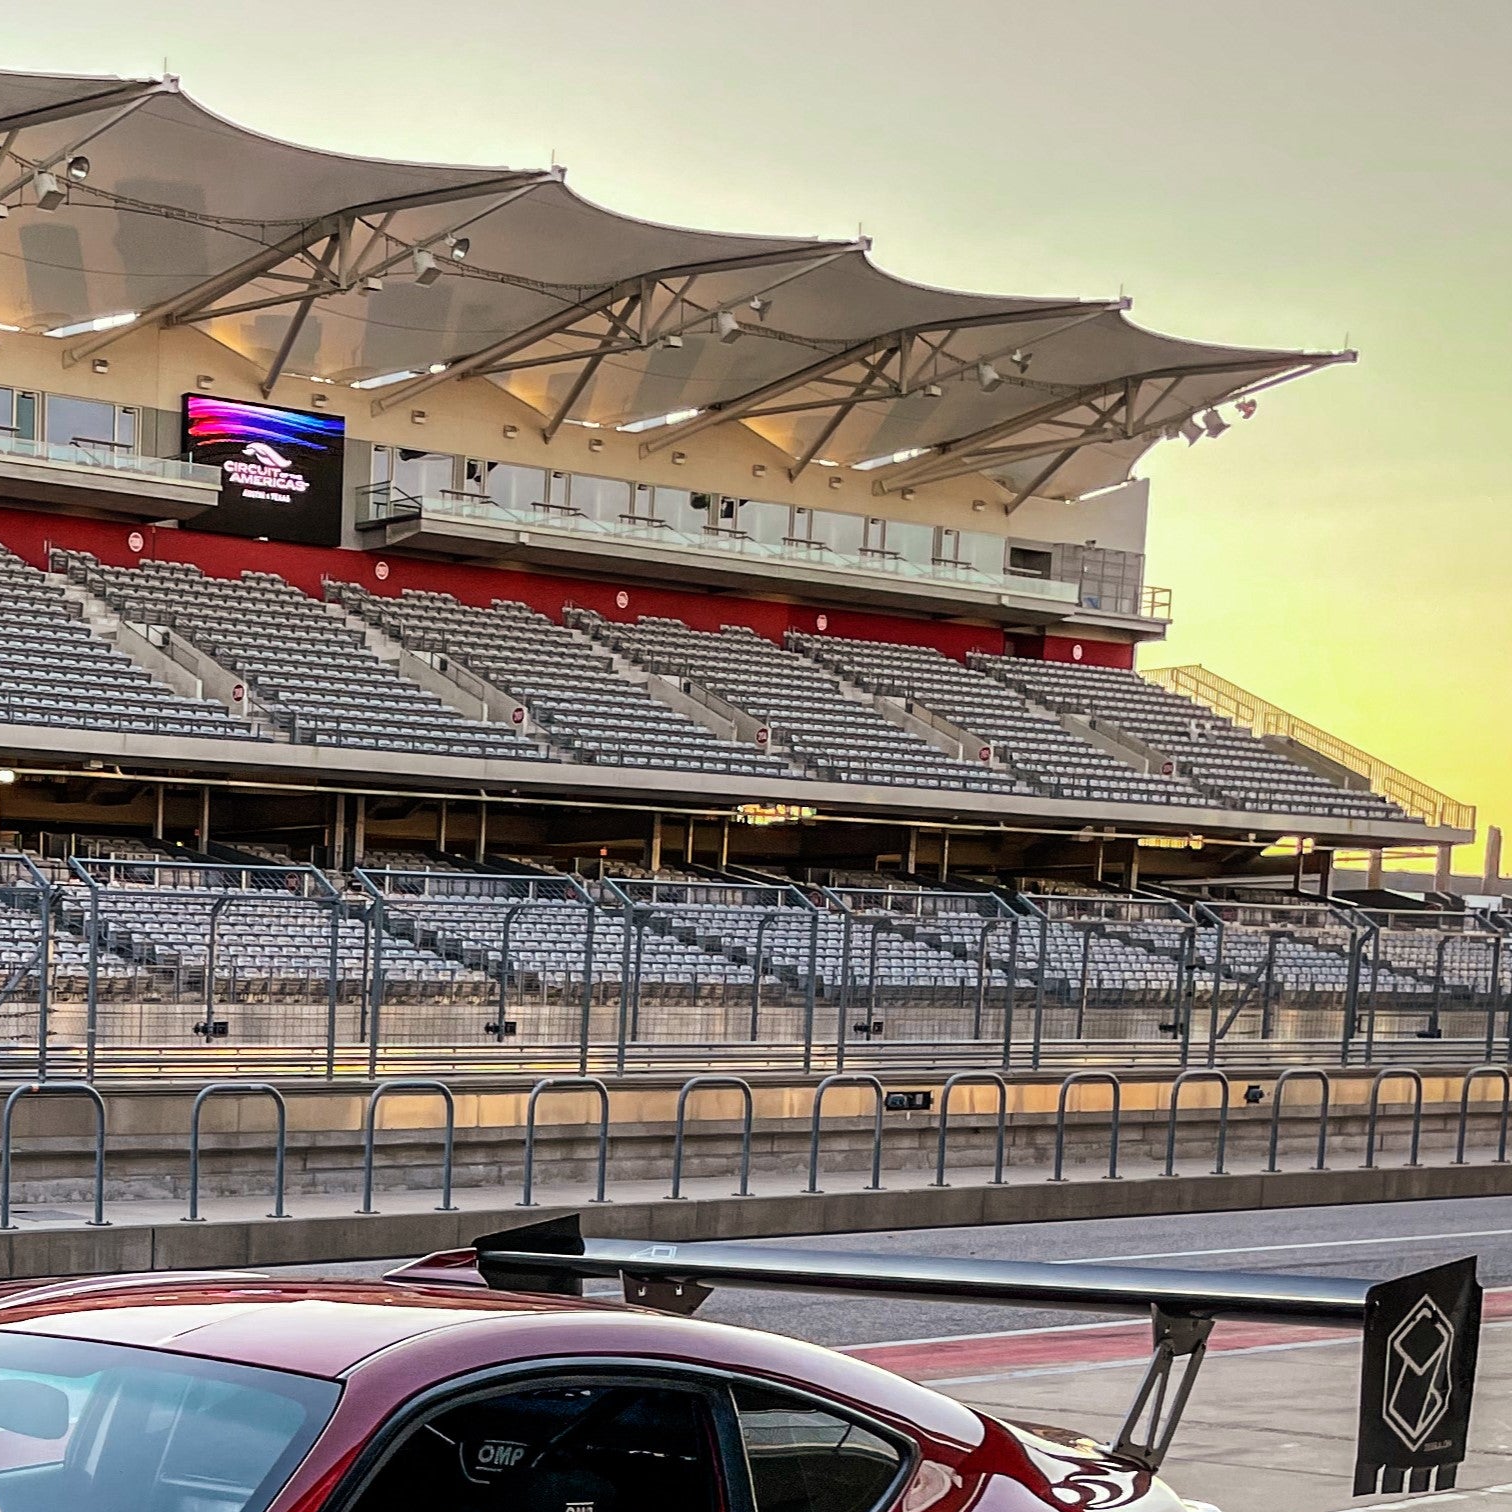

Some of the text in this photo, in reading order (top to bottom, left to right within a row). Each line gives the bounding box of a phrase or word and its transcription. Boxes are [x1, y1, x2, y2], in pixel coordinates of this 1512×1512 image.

[223, 460, 281, 478] CIRCUIT
[229, 472, 306, 492] AMERICAS
[478, 1444, 524, 1466] OMP
